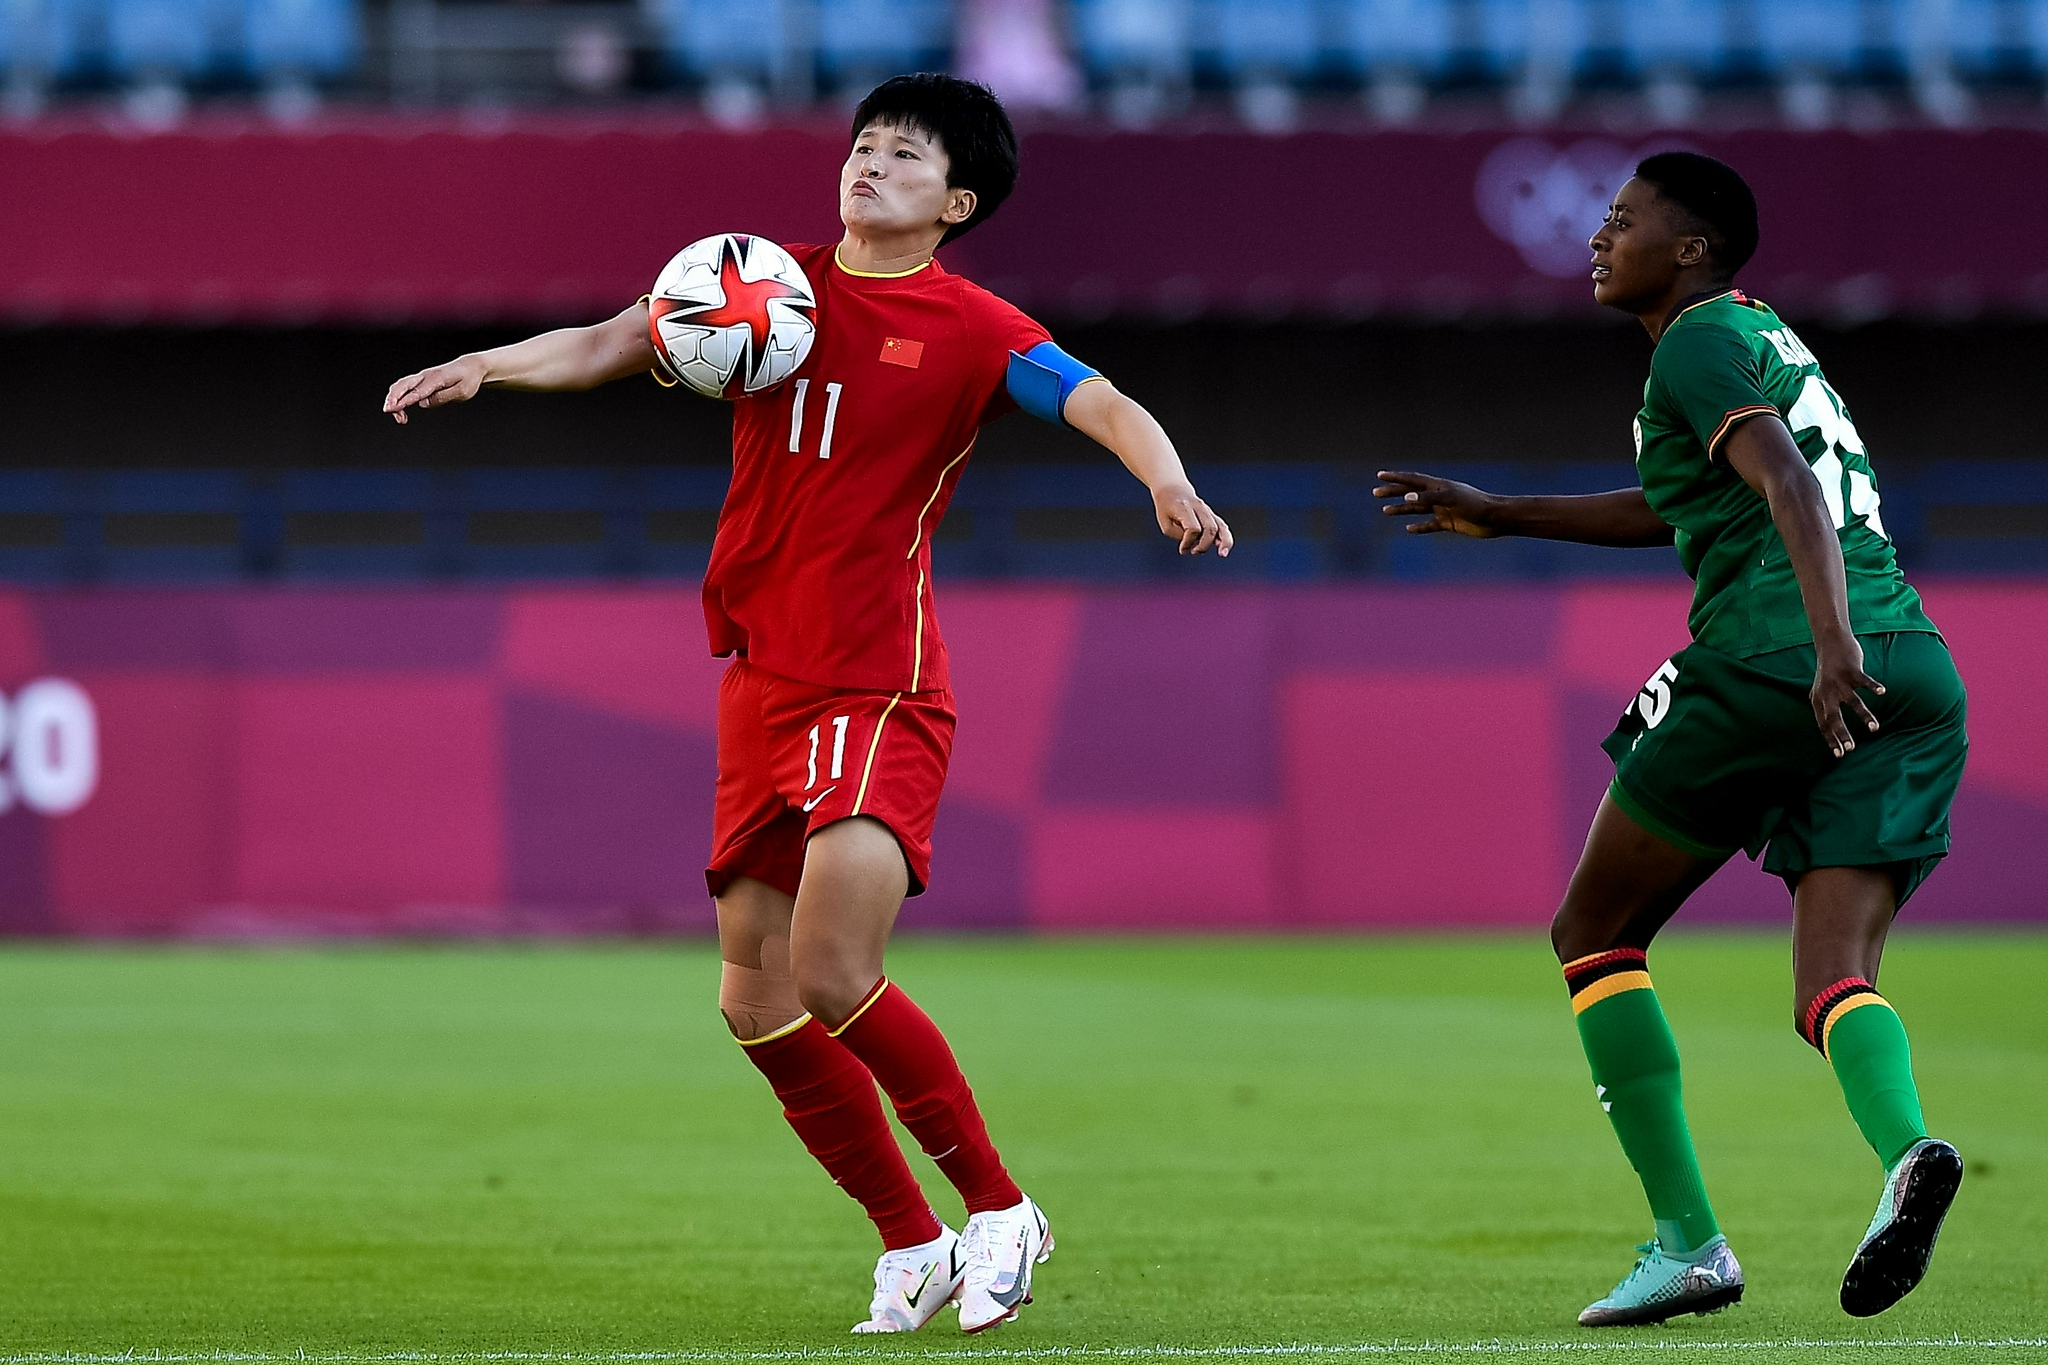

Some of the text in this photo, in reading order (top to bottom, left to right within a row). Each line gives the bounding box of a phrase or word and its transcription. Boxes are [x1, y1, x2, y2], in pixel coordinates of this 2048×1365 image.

[789, 378, 843, 459] 11
[1624, 658, 1679, 729] 5
[0, 676, 98, 817] 0
[803, 715, 850, 791] 11
